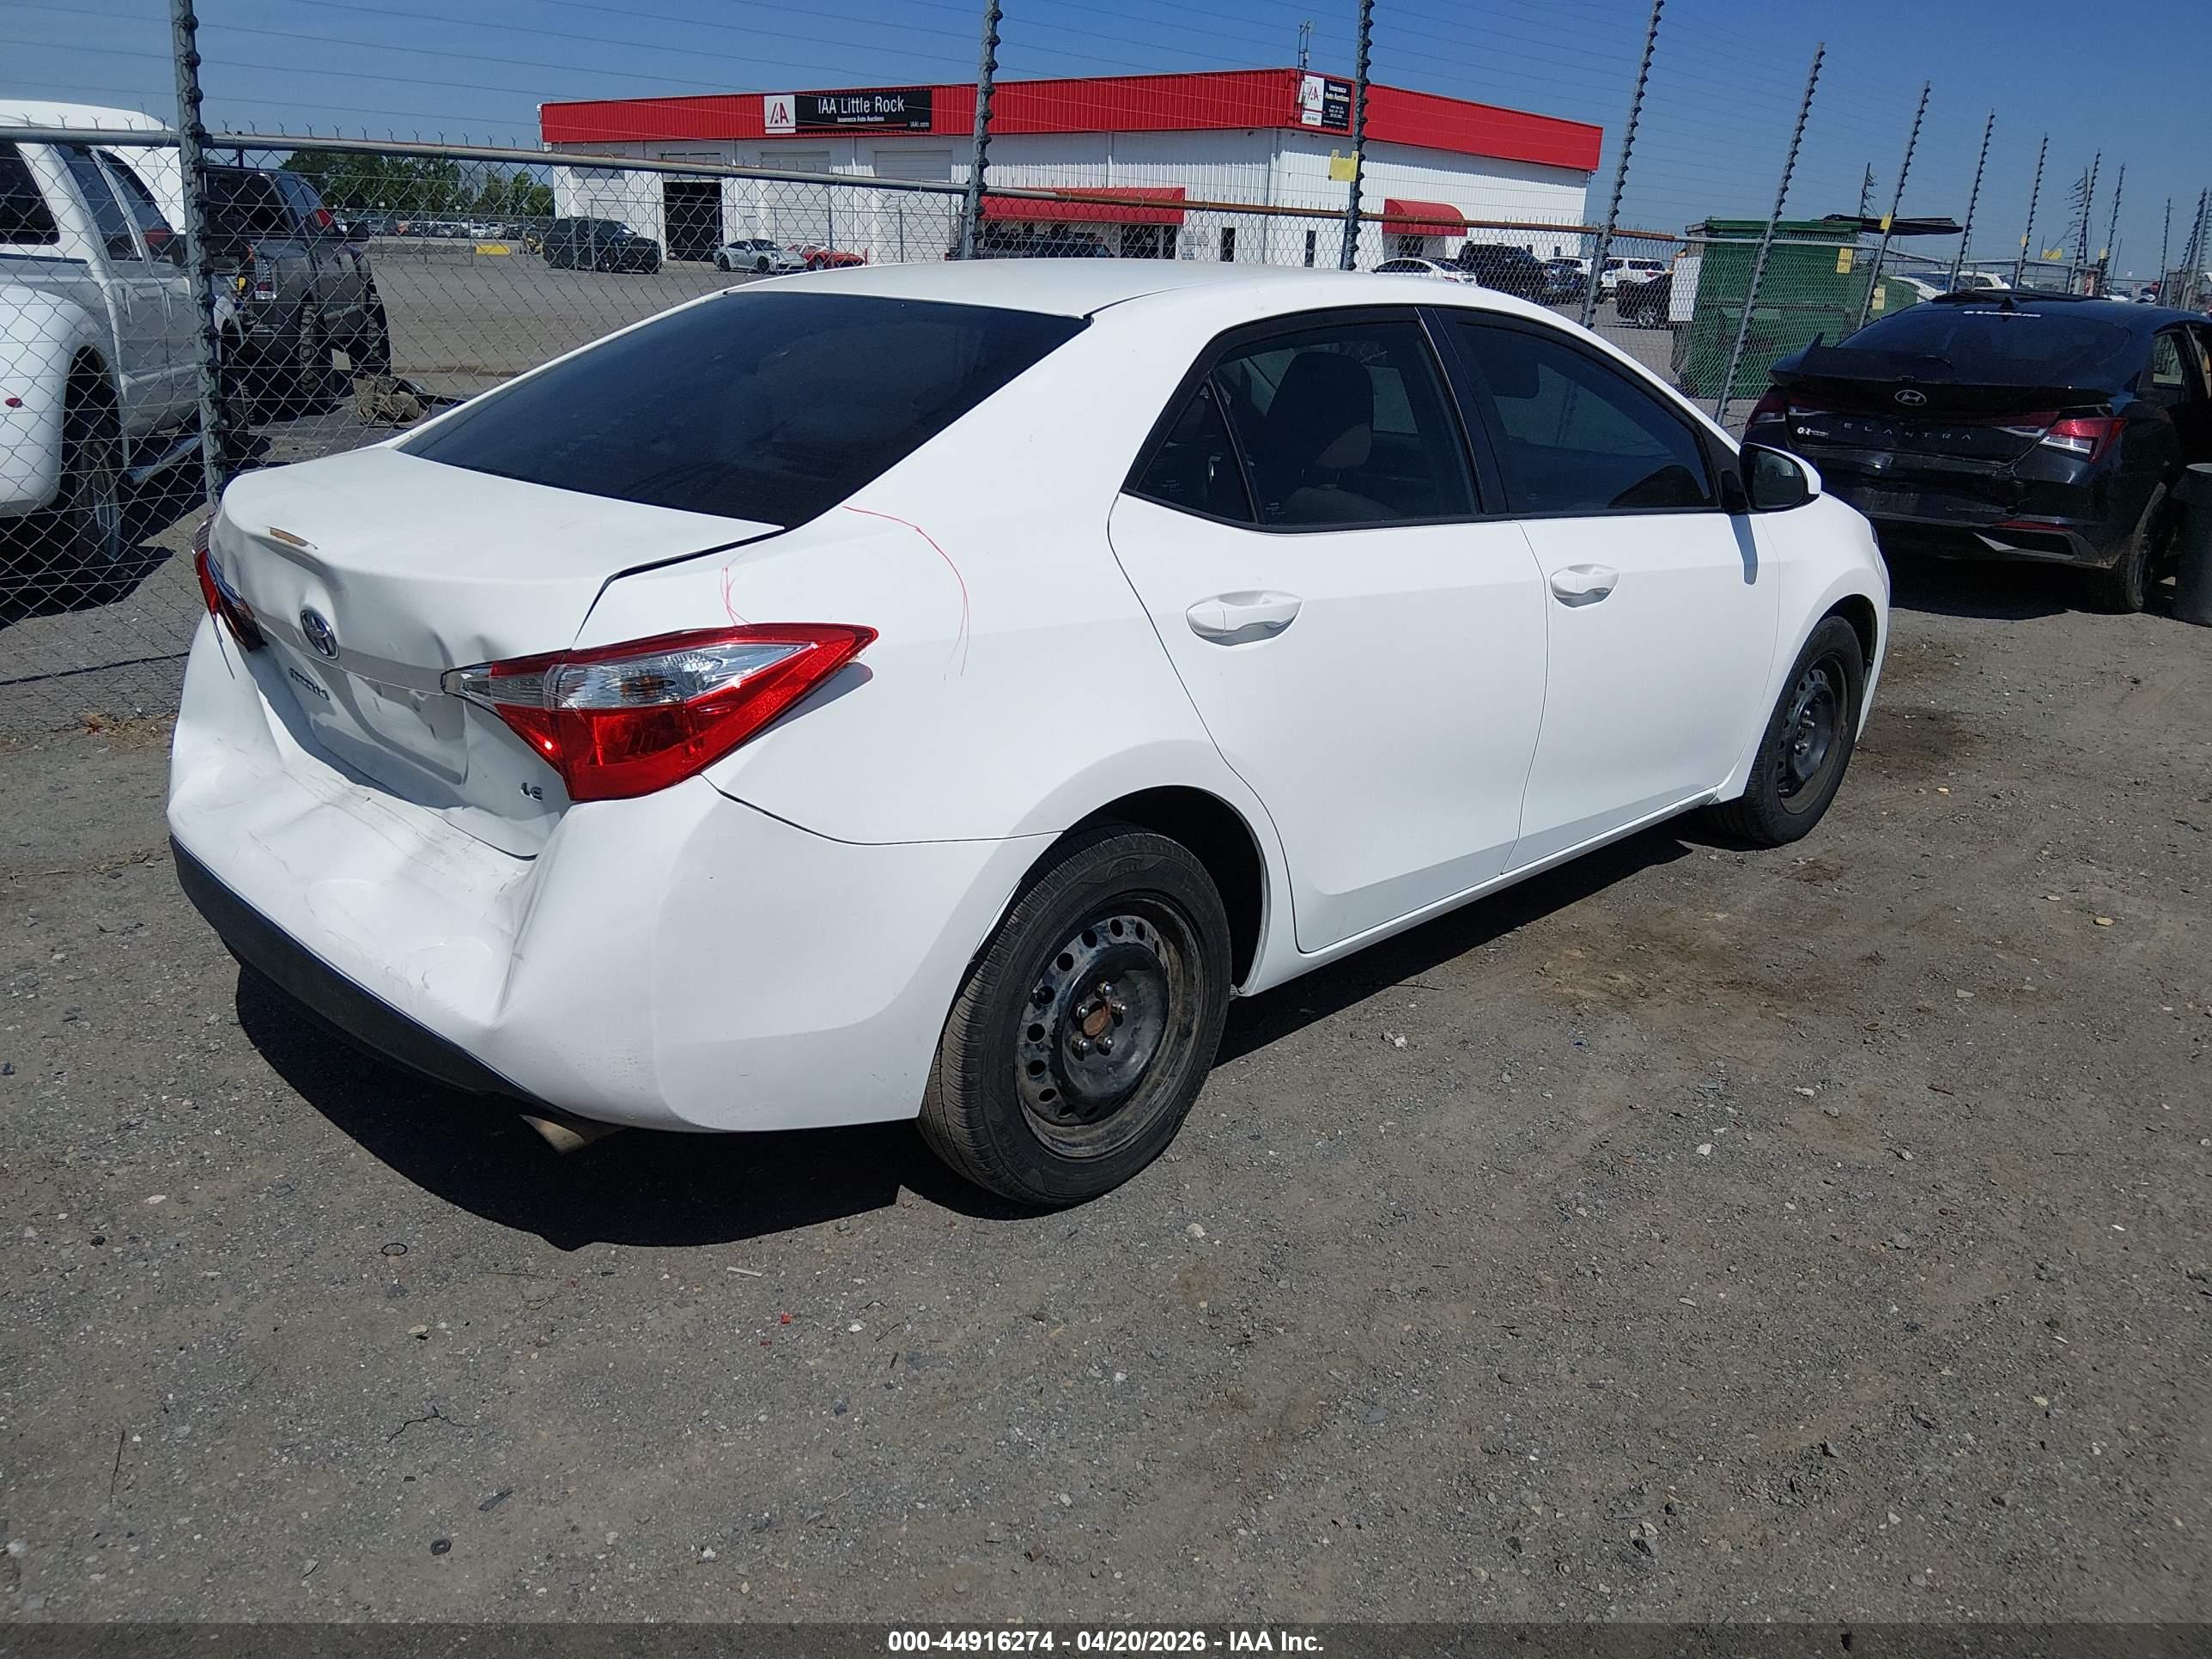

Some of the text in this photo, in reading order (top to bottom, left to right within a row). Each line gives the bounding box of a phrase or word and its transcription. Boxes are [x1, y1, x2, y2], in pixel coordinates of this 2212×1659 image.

[818, 95, 905, 114] IAA Little Rock
[1844, 422, 1972, 441] ELANTRA
